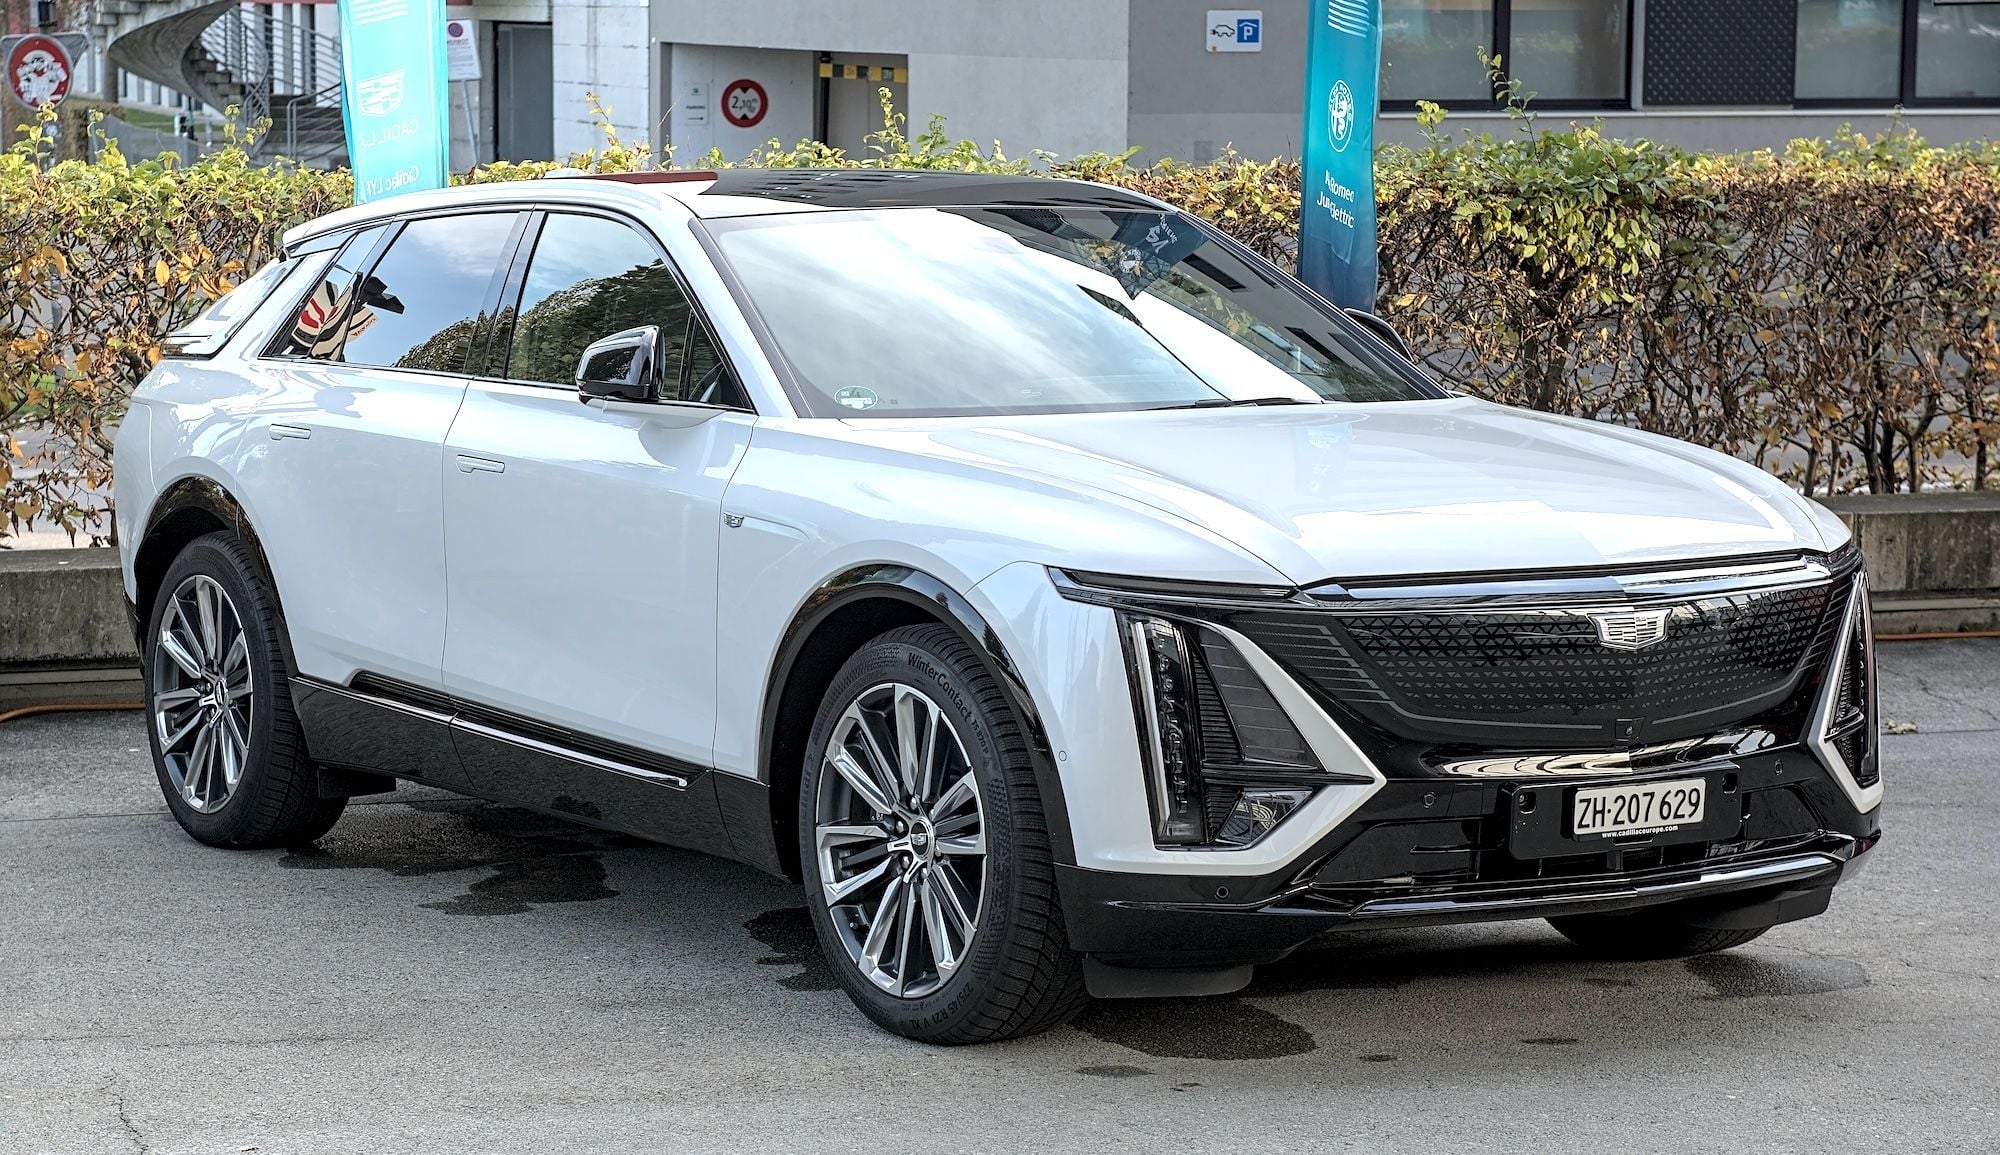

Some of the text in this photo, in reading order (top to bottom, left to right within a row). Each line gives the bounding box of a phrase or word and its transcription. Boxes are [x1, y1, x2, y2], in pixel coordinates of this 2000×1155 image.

[1243, 26, 1253, 40] P
[908, 652, 972, 723] WinterContact
[1659, 787, 1701, 820] 629
[1601, 825, 1679, 838] www.cadillaceurope.com
